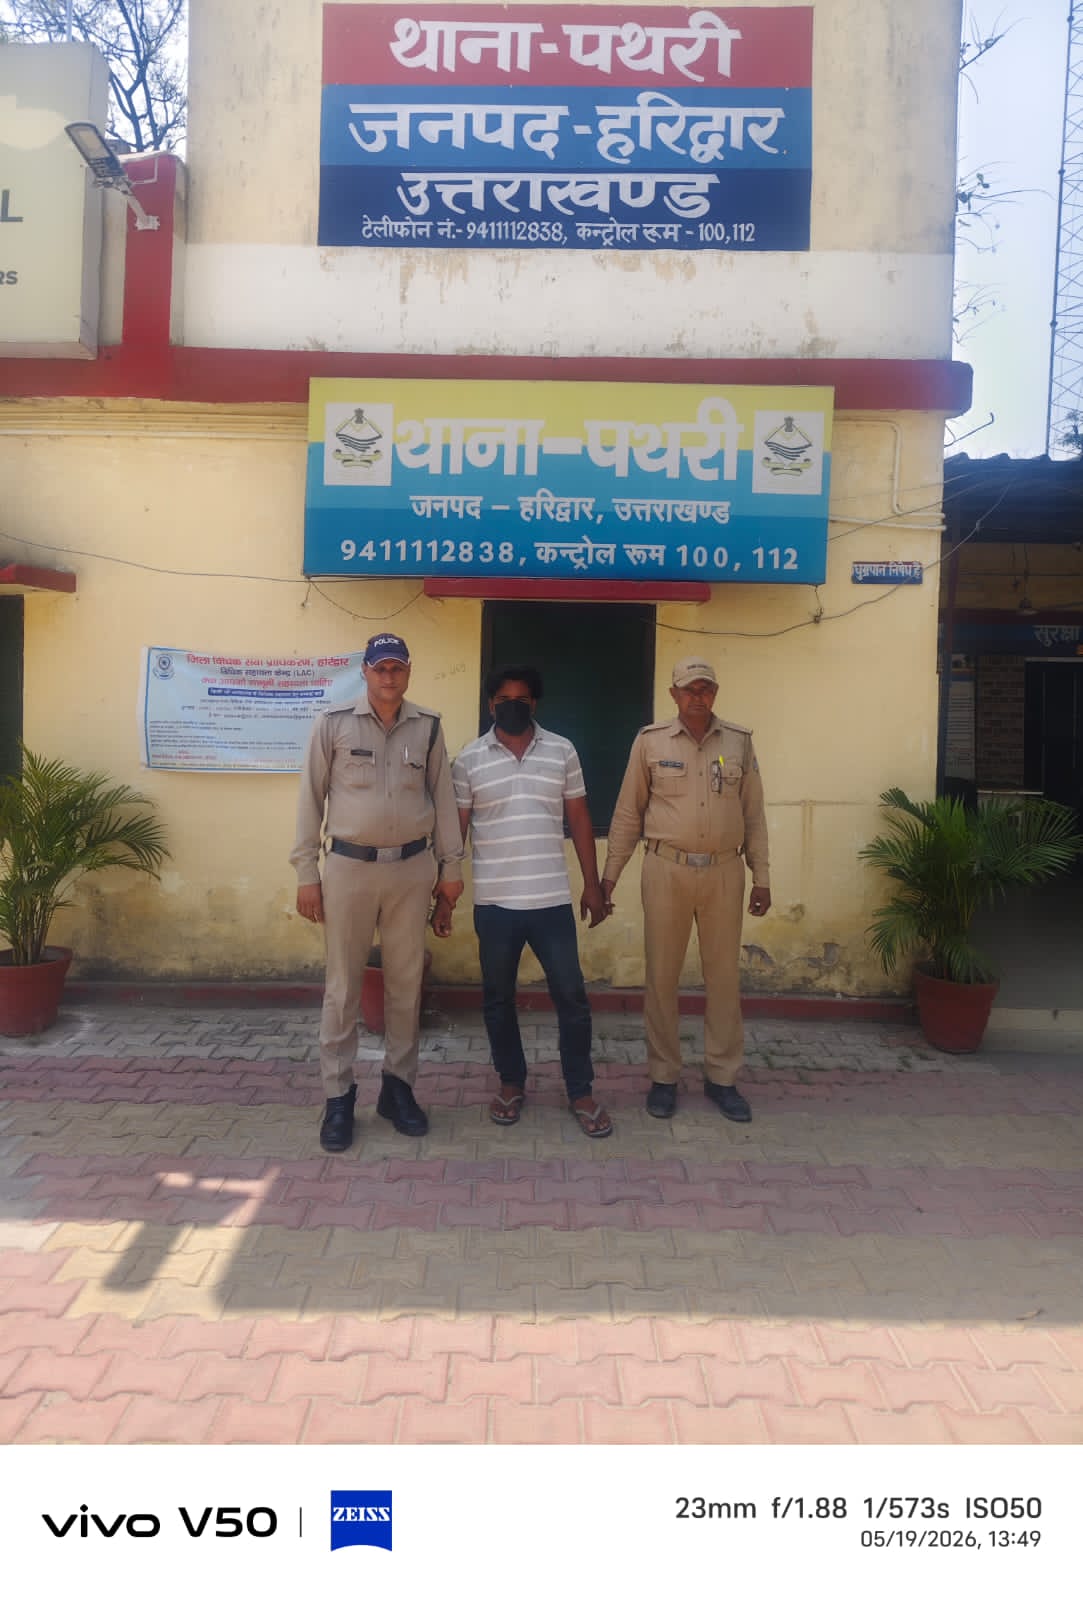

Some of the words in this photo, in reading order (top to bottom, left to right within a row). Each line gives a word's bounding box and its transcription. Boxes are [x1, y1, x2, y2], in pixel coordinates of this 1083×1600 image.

[389, 11, 743, 81] थाना-पथरी
[397, 173, 720, 218] उत्तराखण्ड
[361, 215, 434, 239] टेलीफोन
[576, 217, 640, 246] कन्ट्रोल
[642, 223, 682, 243] रूम
[409, 495, 483, 520] जनपद
[518, 488, 604, 525] हरिद्वार,
[612, 497, 731, 525] उत्तराखण्ड
[340, 539, 527, 567] 9411112838,
[534, 535, 616, 571] कन्ट्रोल
[622, 543, 666, 567] रूम
[677, 545, 741, 573] 100,
[752, 547, 799, 571] 112
[374, 638, 400, 647] POLICE
[1032, 624, 1081, 647] सुरक्षा
